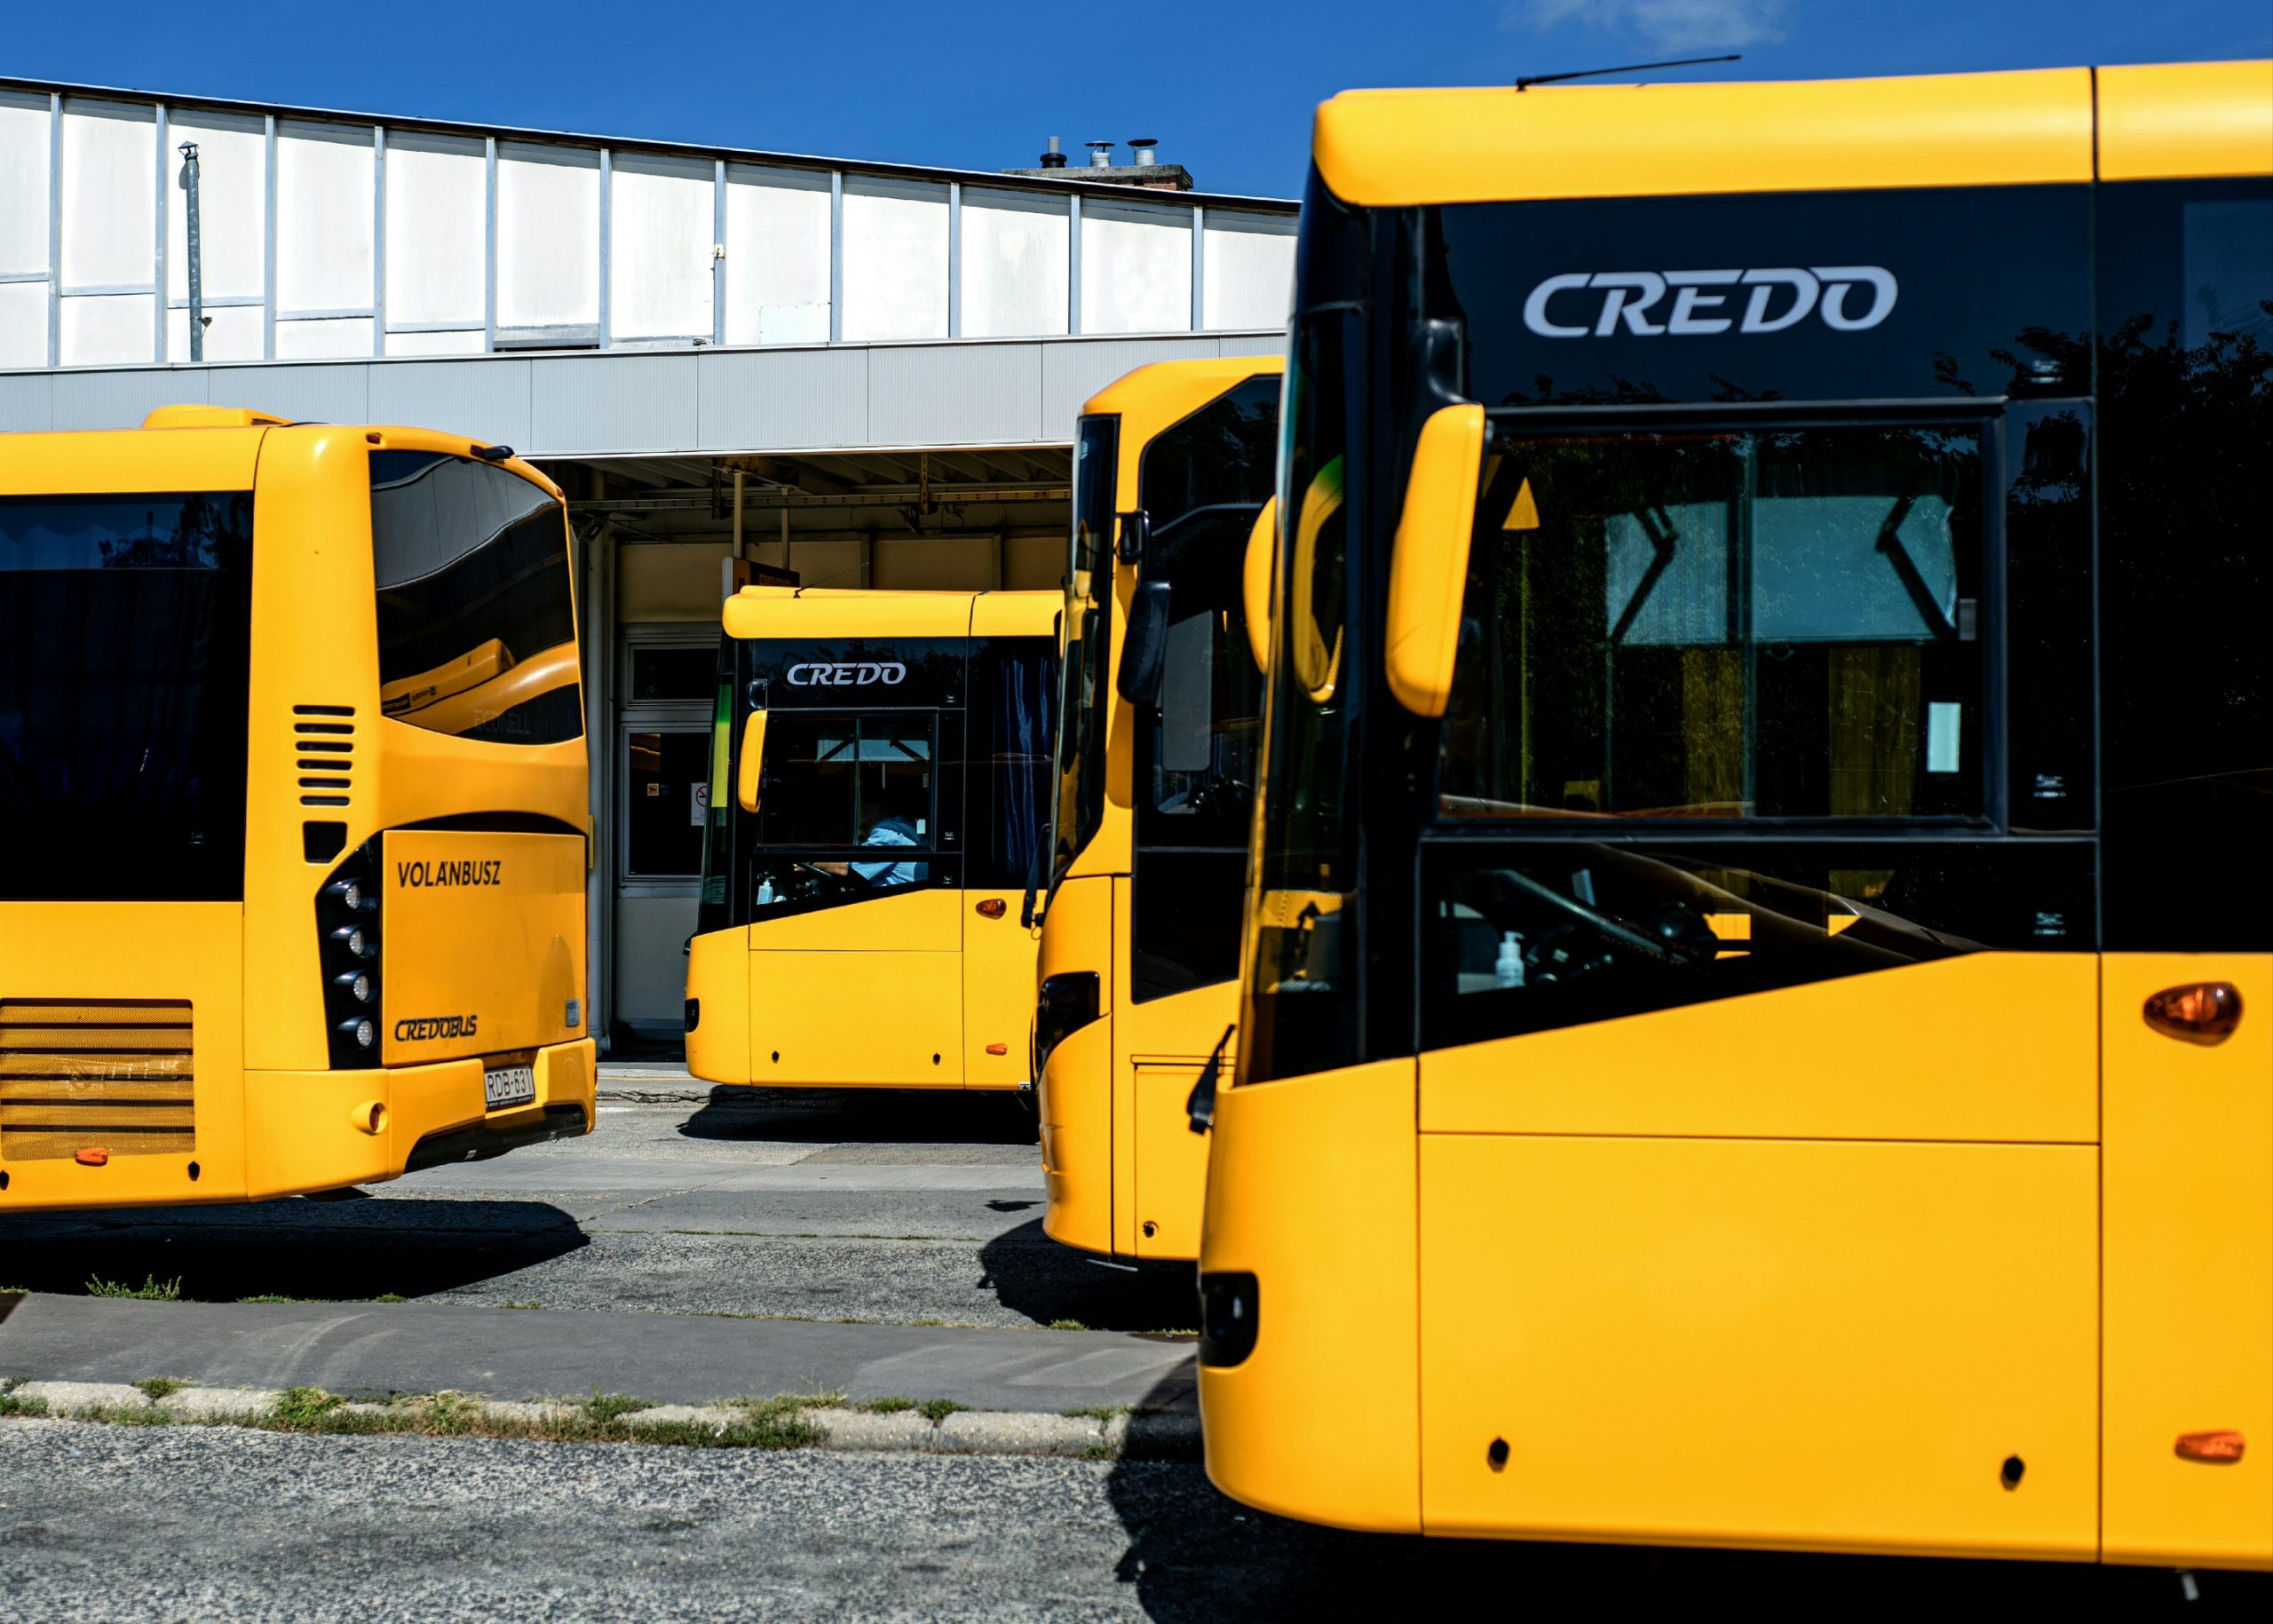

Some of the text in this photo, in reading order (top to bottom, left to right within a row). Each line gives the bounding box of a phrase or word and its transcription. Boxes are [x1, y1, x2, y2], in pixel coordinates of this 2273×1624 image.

[1523, 265, 1899, 337] CREDO
[787, 661, 907, 685] CREDO
[397, 860, 502, 888] VOLÁNBUSZ
[394, 1014, 478, 1042] CREDOBUS
[487, 1069, 531, 1099] RDB-631
